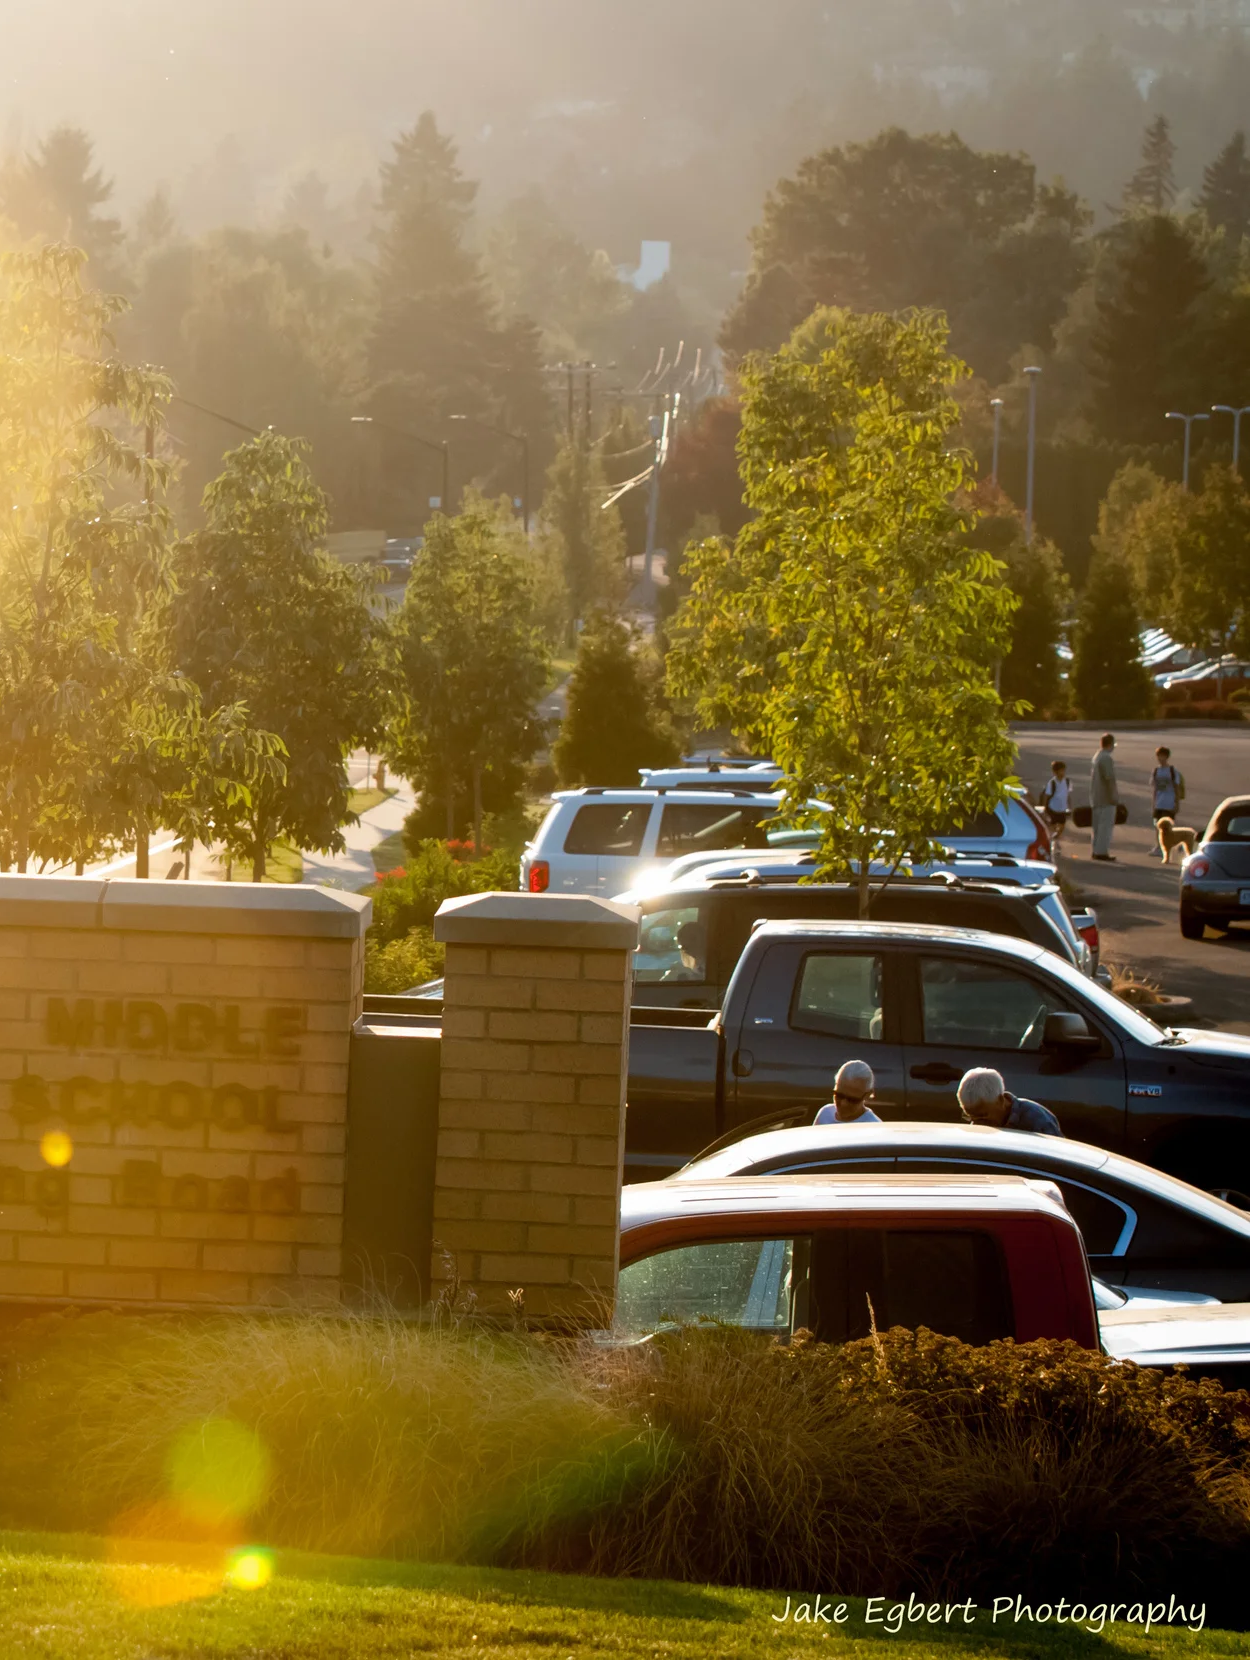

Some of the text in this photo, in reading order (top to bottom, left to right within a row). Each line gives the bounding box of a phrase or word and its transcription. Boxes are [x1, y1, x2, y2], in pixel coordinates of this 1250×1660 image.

[46, 996, 308, 1058] MIDDLE
[11, 1074, 302, 1135] SCHOOL
[122, 1159, 299, 1215] Road
